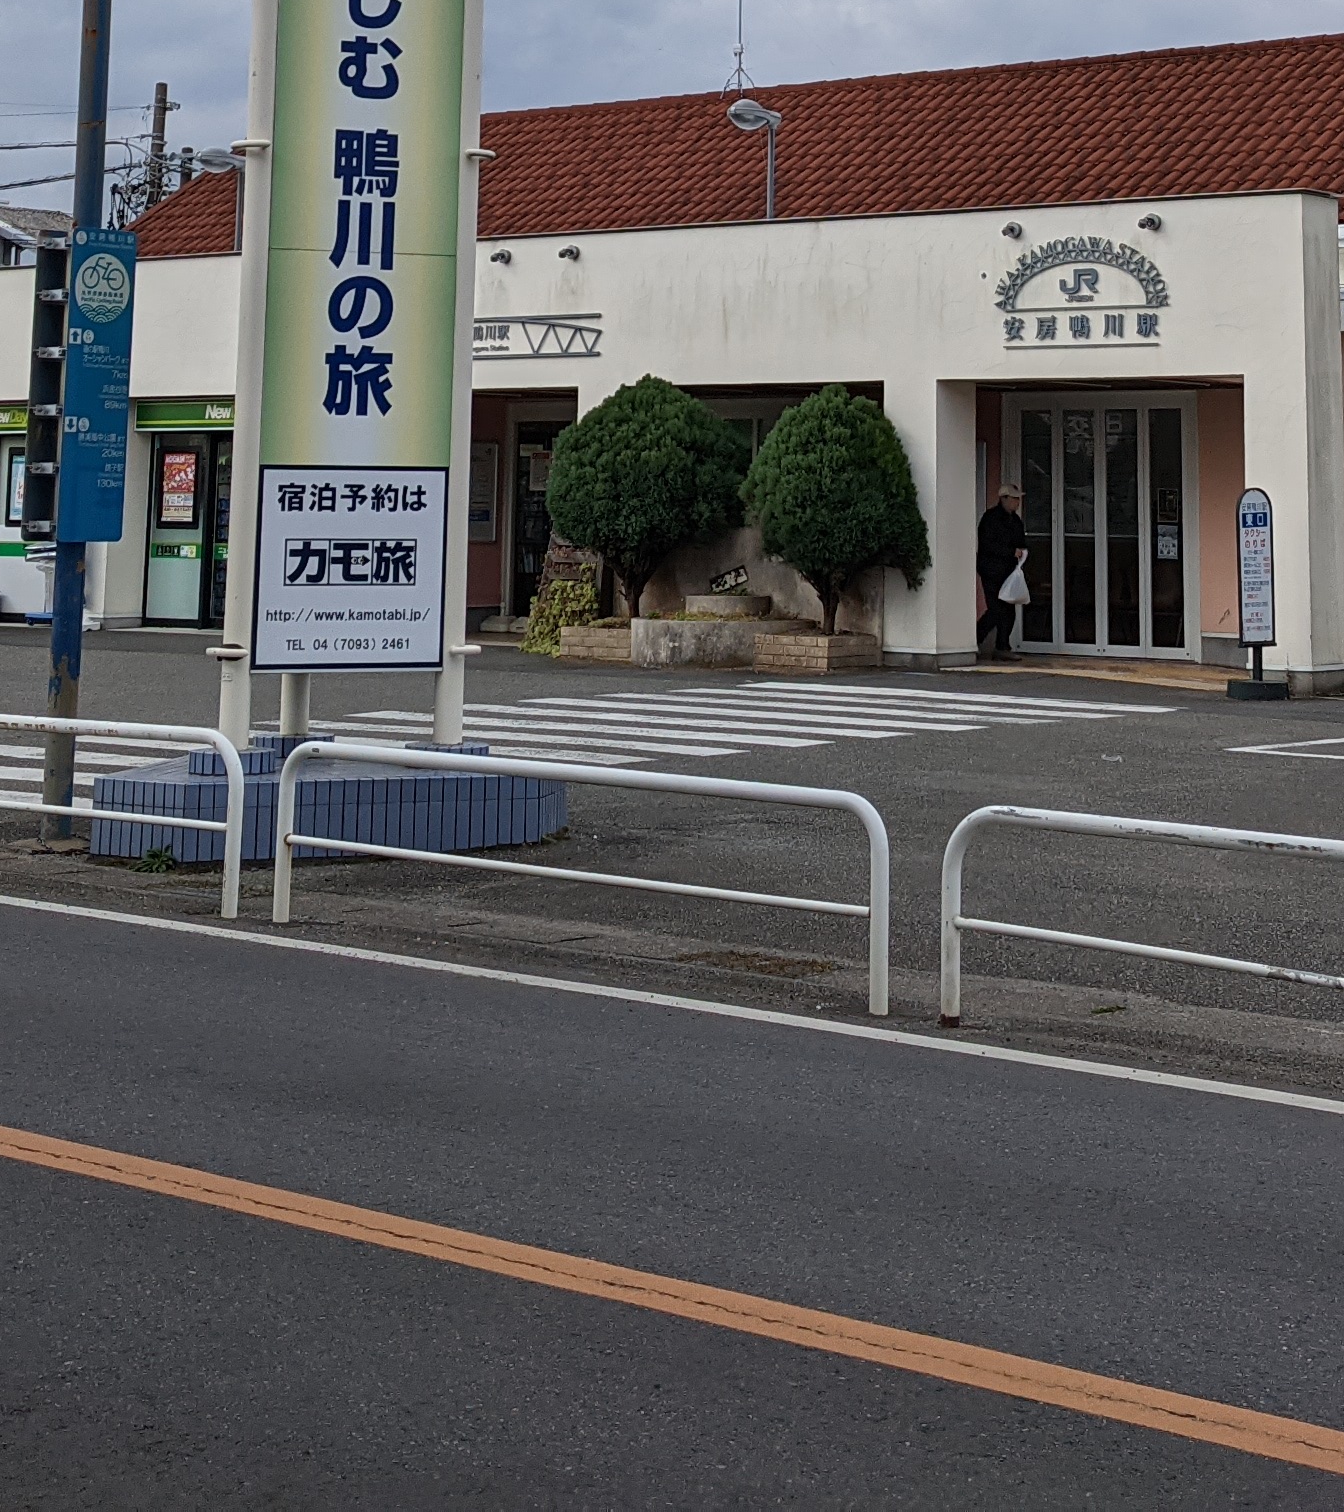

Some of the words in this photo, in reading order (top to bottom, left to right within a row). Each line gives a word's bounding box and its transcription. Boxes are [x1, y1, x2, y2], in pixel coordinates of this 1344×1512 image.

[322, 127, 402, 417] 鴨川の旅
[1059, 267, 1100, 295] JR
[1002, 312, 1160, 342] 安房鴨川駅
[205, 404, 233, 419] New
[277, 482, 428, 513] 宿泊予約は
[286, 540, 416, 584] カモ旅
[265, 607, 431, 623] http://www.kamotabi.jp/
[285, 638, 306, 651] TEL
